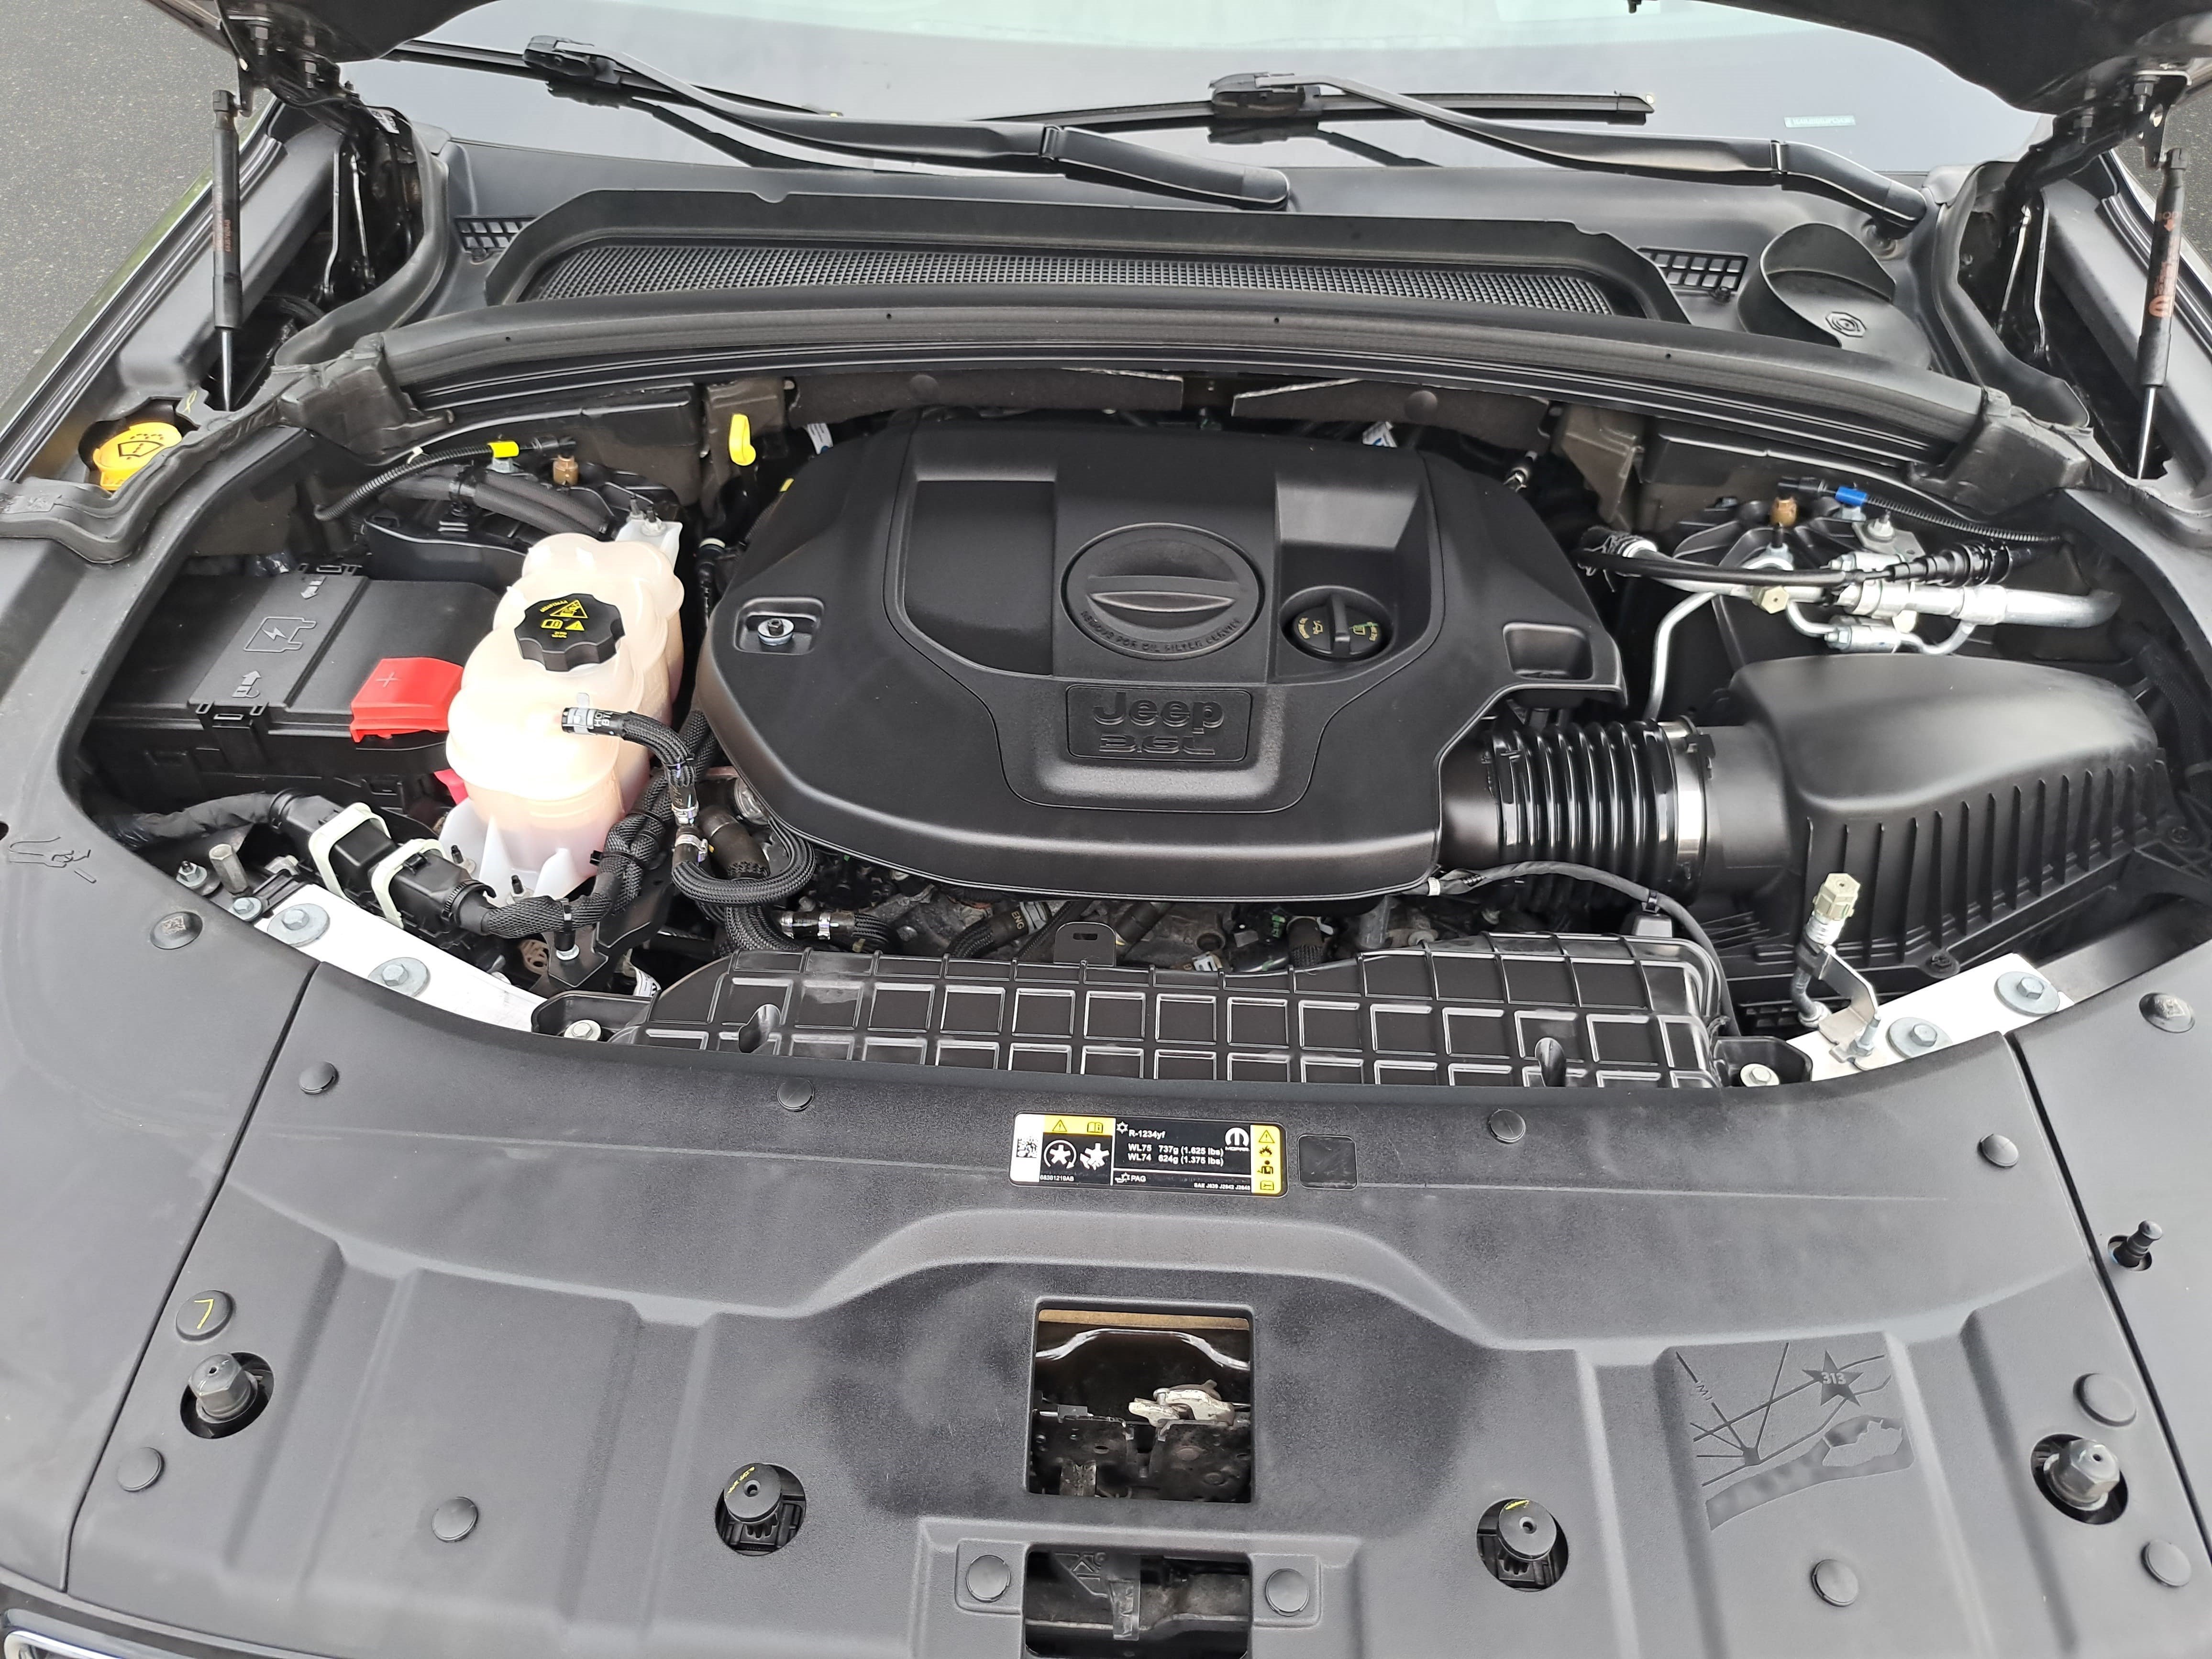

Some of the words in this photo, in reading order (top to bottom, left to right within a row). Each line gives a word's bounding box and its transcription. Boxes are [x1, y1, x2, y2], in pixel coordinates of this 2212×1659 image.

[594, 709, 604, 727] HO
[1092, 692, 1225, 734] Jeep
[1099, 734, 1216, 755] 3.6L
[1011, 911, 1025, 930] ENG
[1128, 1129, 1166, 1140] R-1234yf
[1128, 1143, 1152, 1152] WL75
[1158, 1145, 1179, 1155] 737g
[1207, 1147, 1224, 1157] lbs)
[1128, 1153, 1152, 1161] WL74
[1158, 1155, 1179, 1164] 624g
[1180, 1155, 1206, 1165] (1.375
[1207, 1157, 1224, 1167] lbs)
[194, 1298, 214, 1329] 7
[1821, 1371, 1847, 1385] 313
